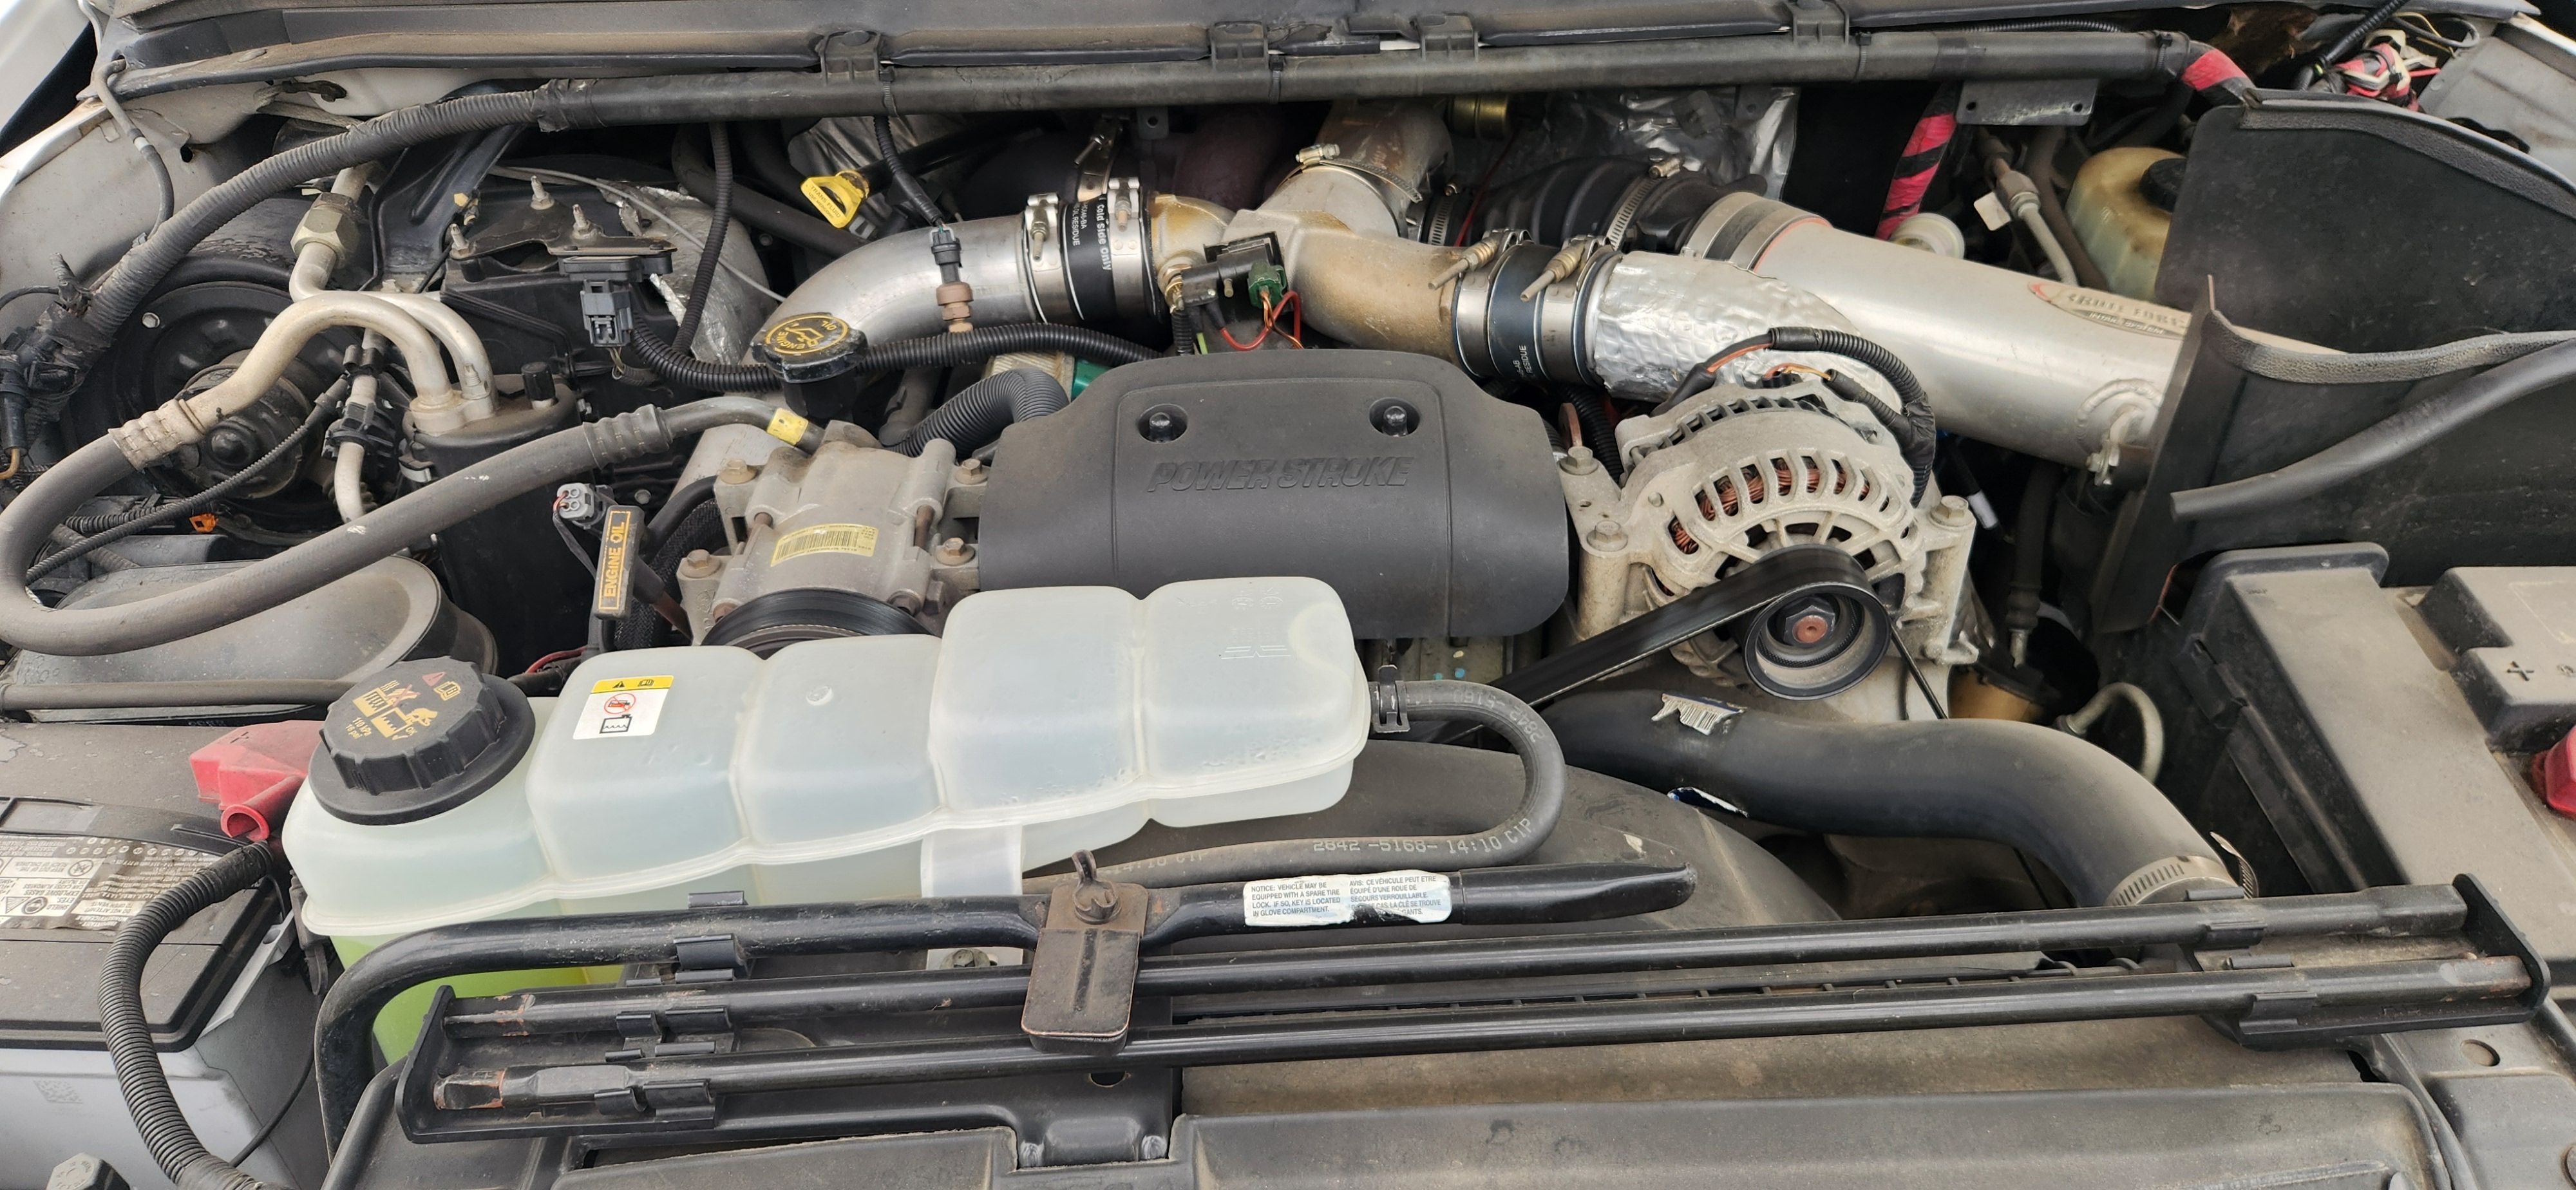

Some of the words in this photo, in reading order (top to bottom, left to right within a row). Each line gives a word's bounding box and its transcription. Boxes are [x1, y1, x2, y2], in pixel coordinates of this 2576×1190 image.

[810, 185, 827, 203] TRANS
[828, 202, 841, 218] FLUID
[1072, 216, 1081, 246] RESIDUE
[777, 331, 806, 350] ENGINE
[822, 320, 837, 330] OIL
[1147, 458, 1278, 493] POWER
[1276, 456, 1414, 489] STROKE
[610, 522, 625, 543] OIL
[603, 547, 623, 598] ENGINE
[1313, 840, 1360, 852] 2842
[1448, 836, 1502, 854] 14:10
[1504, 818, 1531, 844] CIP
[1375, 876, 1404, 885] VÉHICULE
[1282, 906, 1330, 915] COMPARTMENT.
[1379, 892, 1428, 900] VERROUILLABLE.
